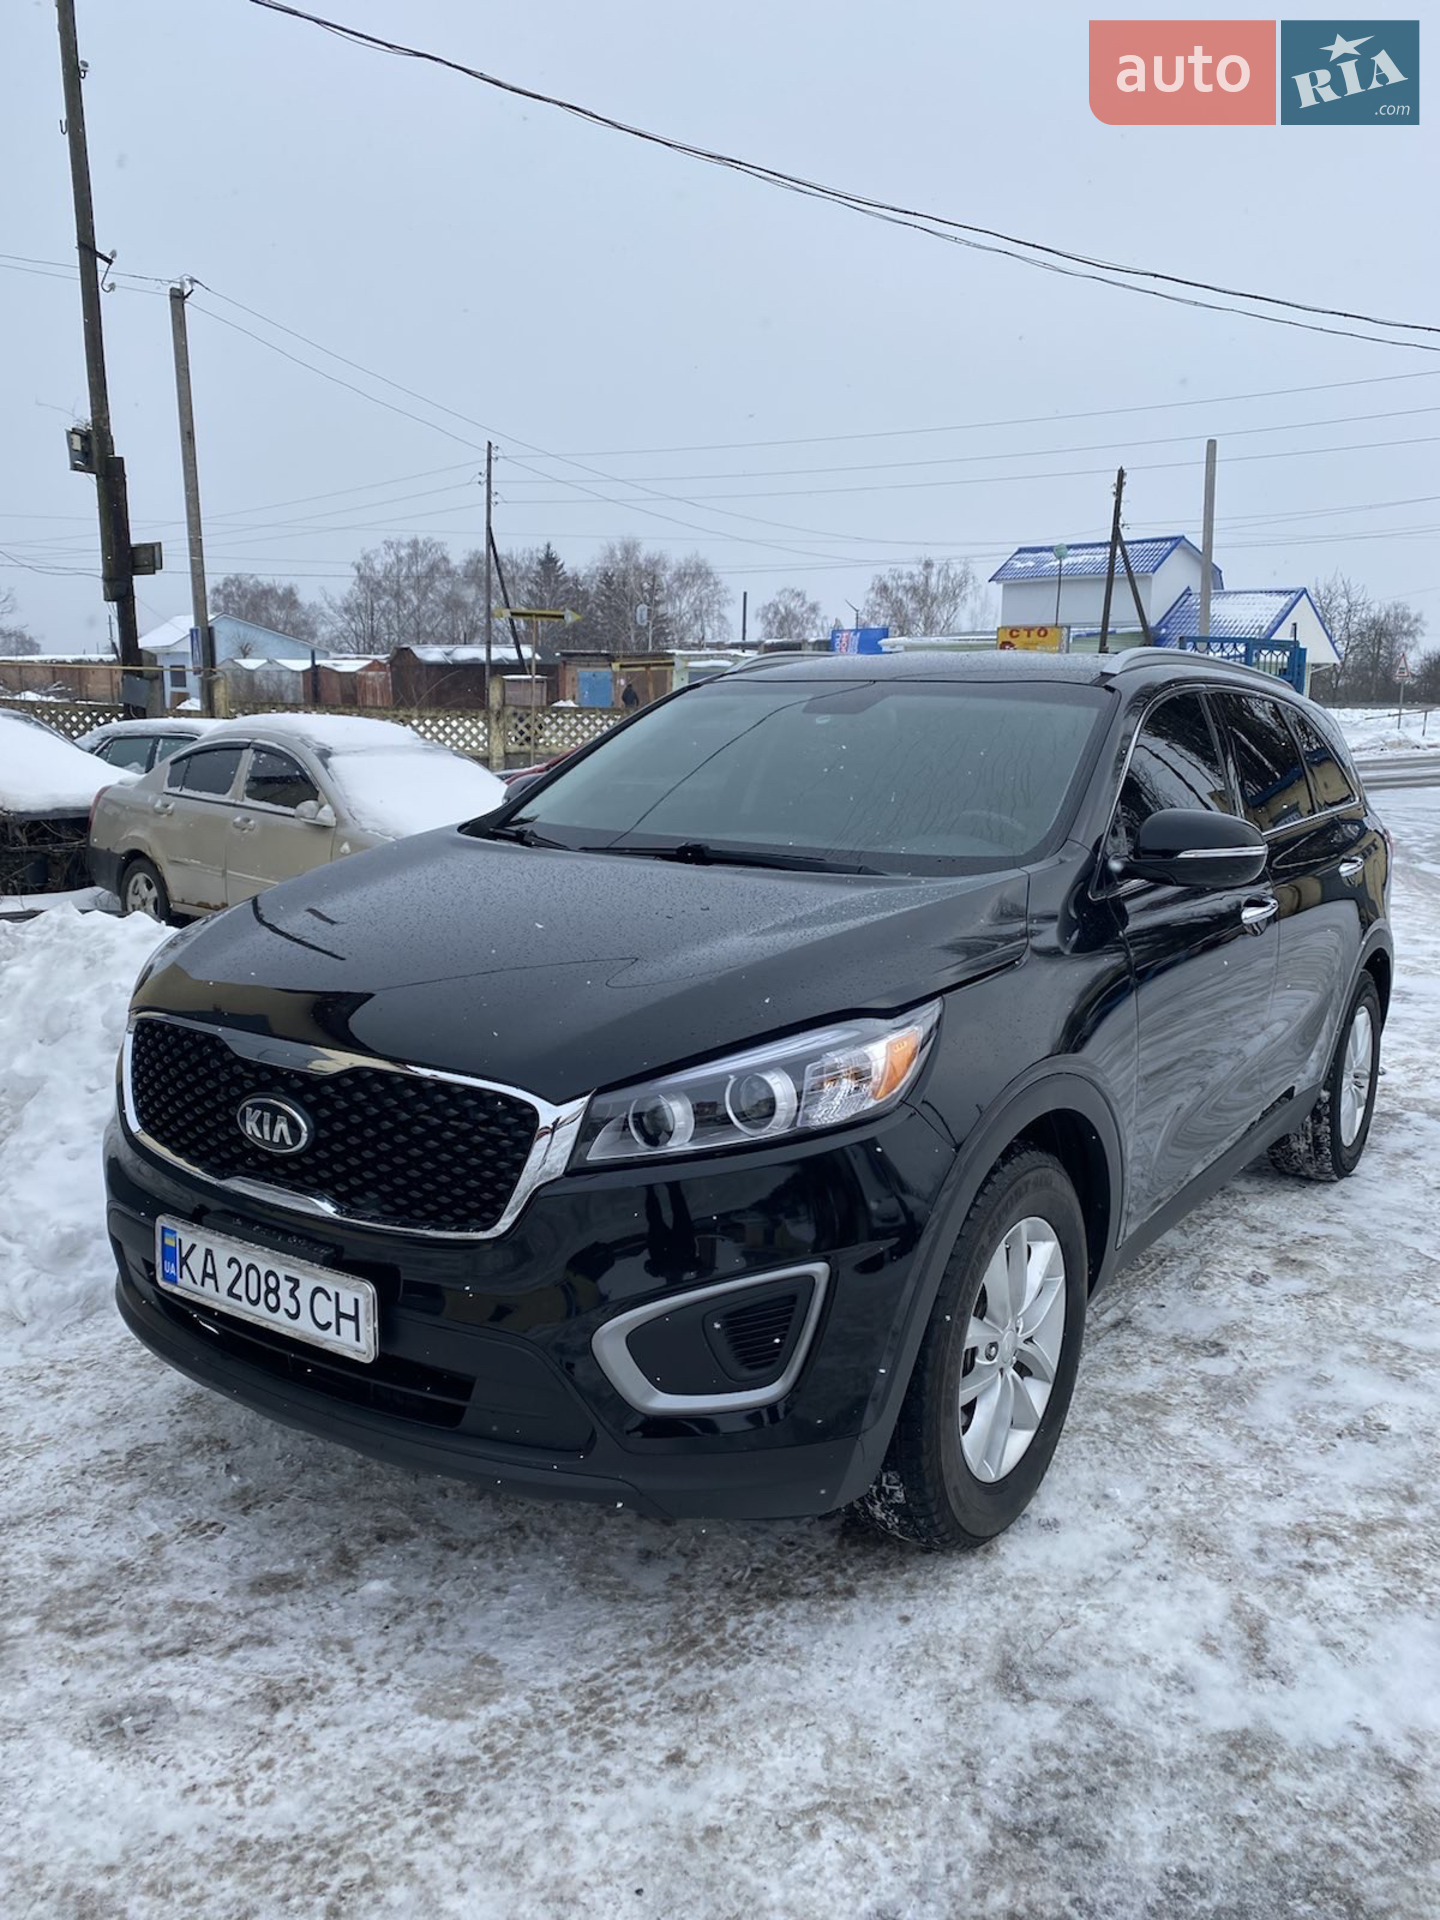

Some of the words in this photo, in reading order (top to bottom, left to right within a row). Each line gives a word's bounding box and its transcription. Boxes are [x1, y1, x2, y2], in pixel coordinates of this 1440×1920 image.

[1009, 627, 1048, 639] СТО
[245, 1106, 294, 1146] KIA
[164, 1259, 176, 1277] UA
[178, 1237, 220, 1293] KA
[226, 1256, 301, 1321] 2083
[309, 1285, 361, 1343] CH
